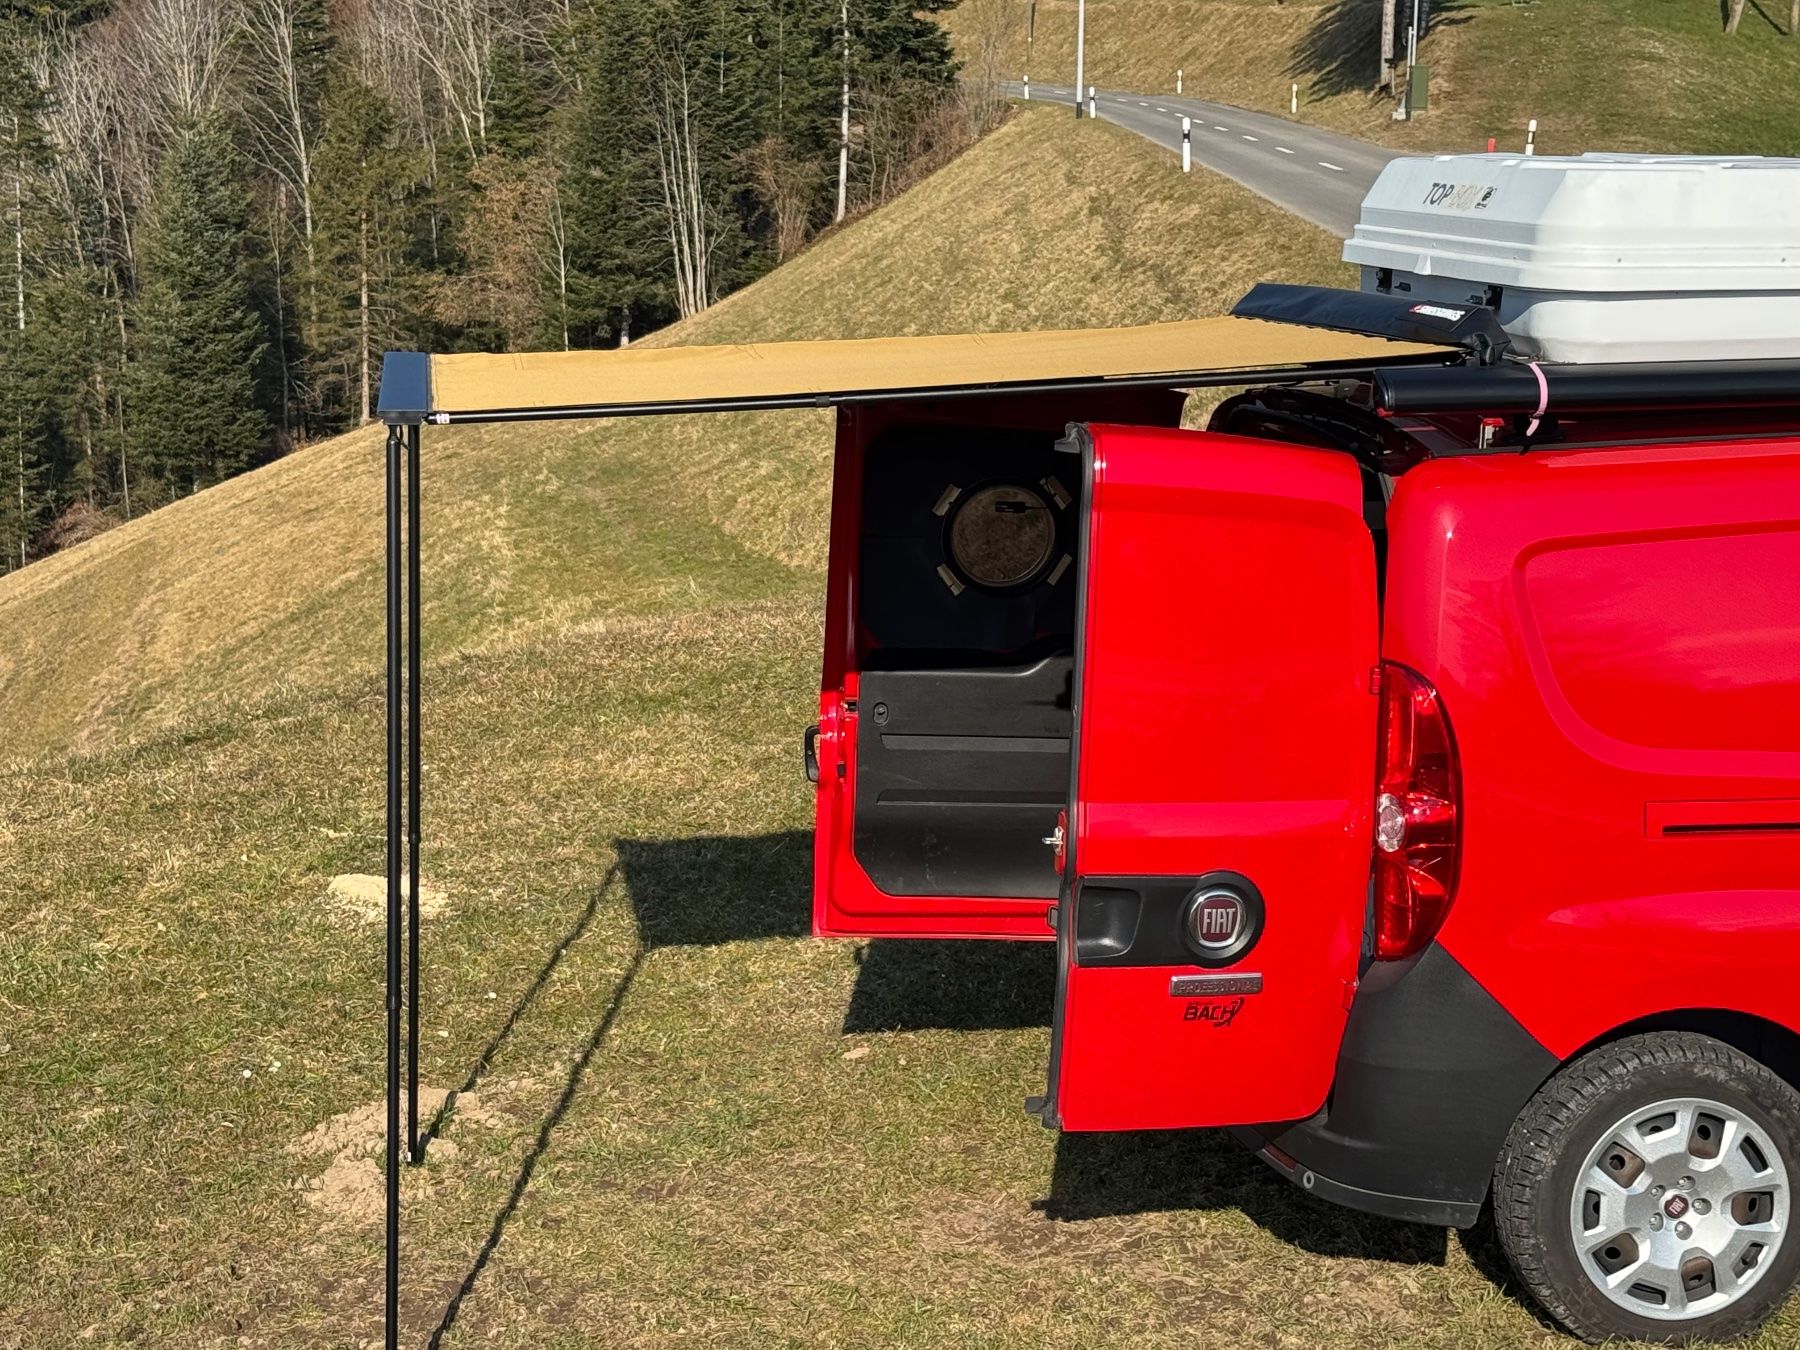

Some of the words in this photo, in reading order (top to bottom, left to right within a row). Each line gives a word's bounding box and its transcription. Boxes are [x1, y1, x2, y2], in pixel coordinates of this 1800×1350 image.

[1422, 182, 1455, 206] TOP
[1203, 908, 1236, 934] FIAT
[1184, 1002, 1237, 1022] BACH
